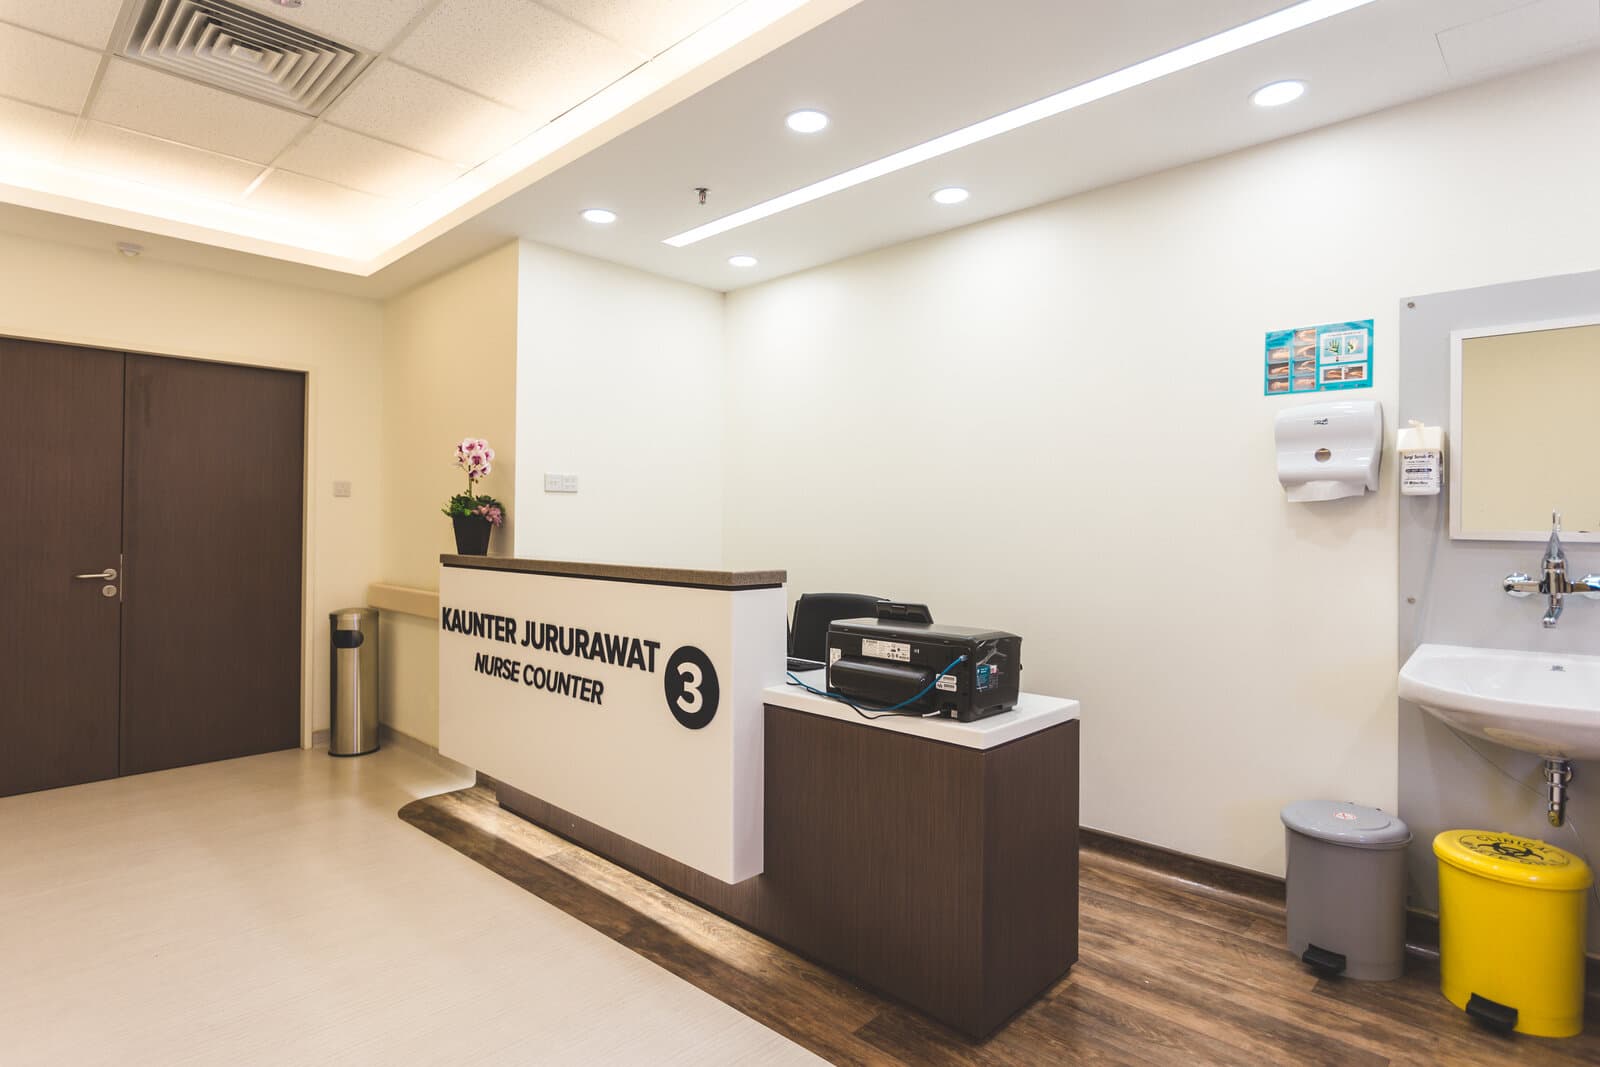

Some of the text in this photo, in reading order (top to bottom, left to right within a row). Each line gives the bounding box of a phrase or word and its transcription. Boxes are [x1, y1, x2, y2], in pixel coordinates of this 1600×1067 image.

[442, 606, 661, 673] KAUNTER JURURAWAT
[474, 652, 605, 705] NURSE COUNTER
[676, 661, 703, 714] 3
